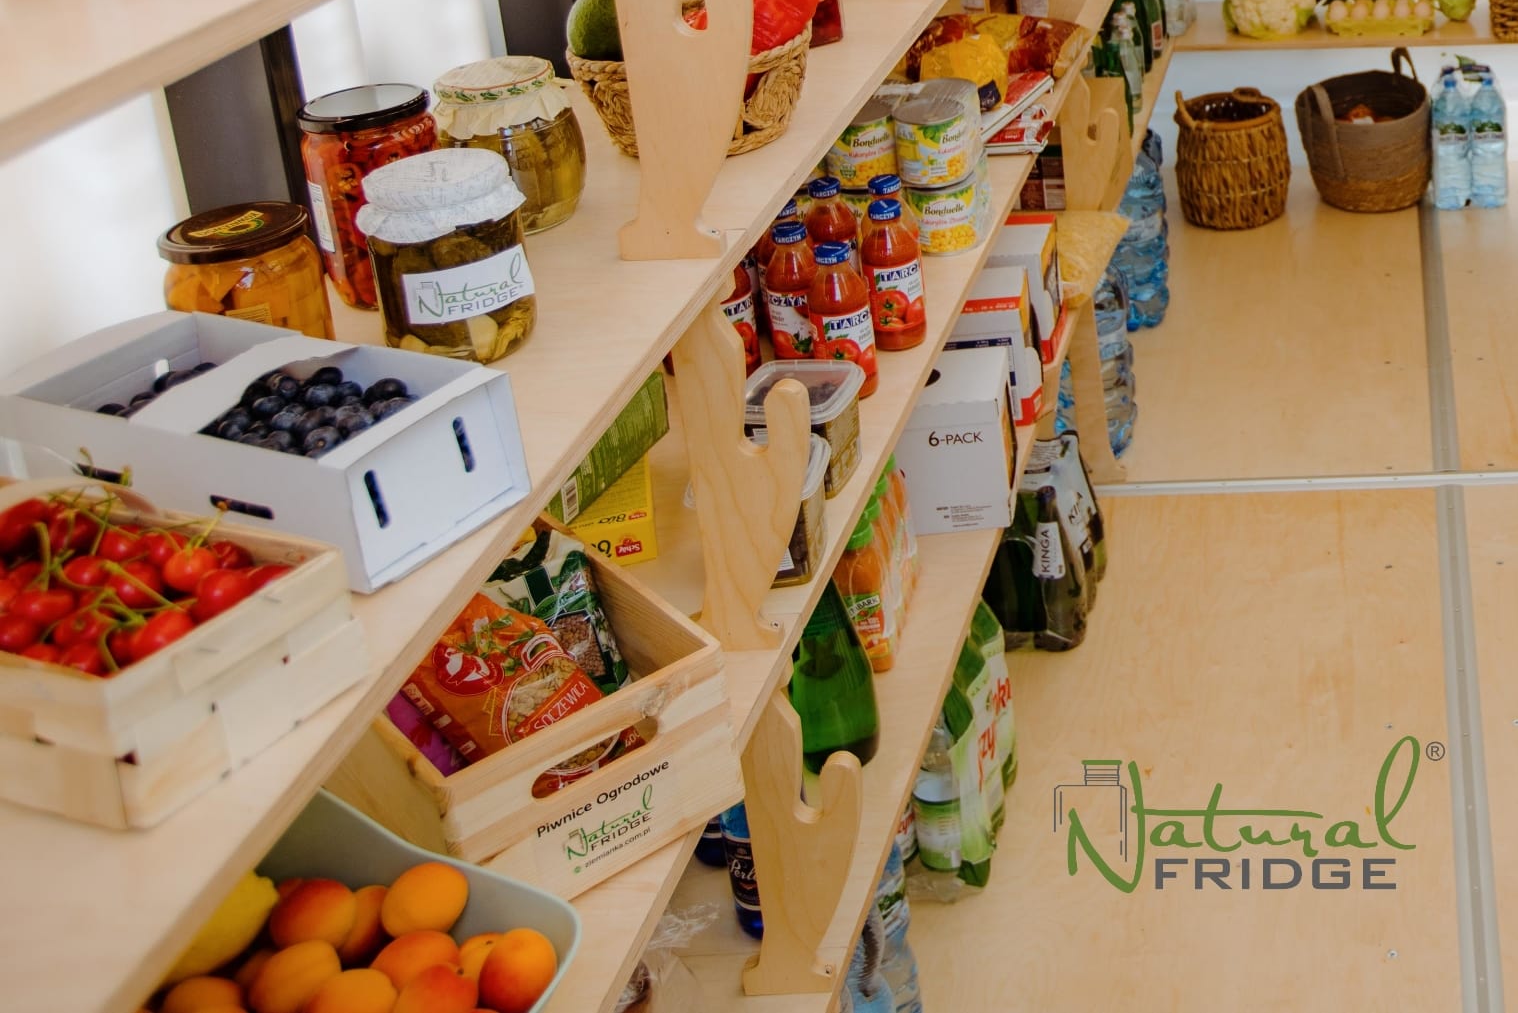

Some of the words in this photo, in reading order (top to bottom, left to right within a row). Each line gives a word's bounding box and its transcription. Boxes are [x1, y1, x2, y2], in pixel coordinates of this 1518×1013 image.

[924, 203, 965, 217] Bonduelle
[417, 253, 523, 319] Natural
[447, 289, 519, 317] FRIDGE
[928, 430, 984, 447] 6-PACK
[1041, 529, 1050, 573] KINGA
[533, 680, 588, 731] SOCZEWICA
[536, 802, 593, 838] Piwnice
[595, 760, 670, 805] Ogrodowe
[566, 783, 655, 860] Natural
[590, 812, 652, 852] FRIDGE
